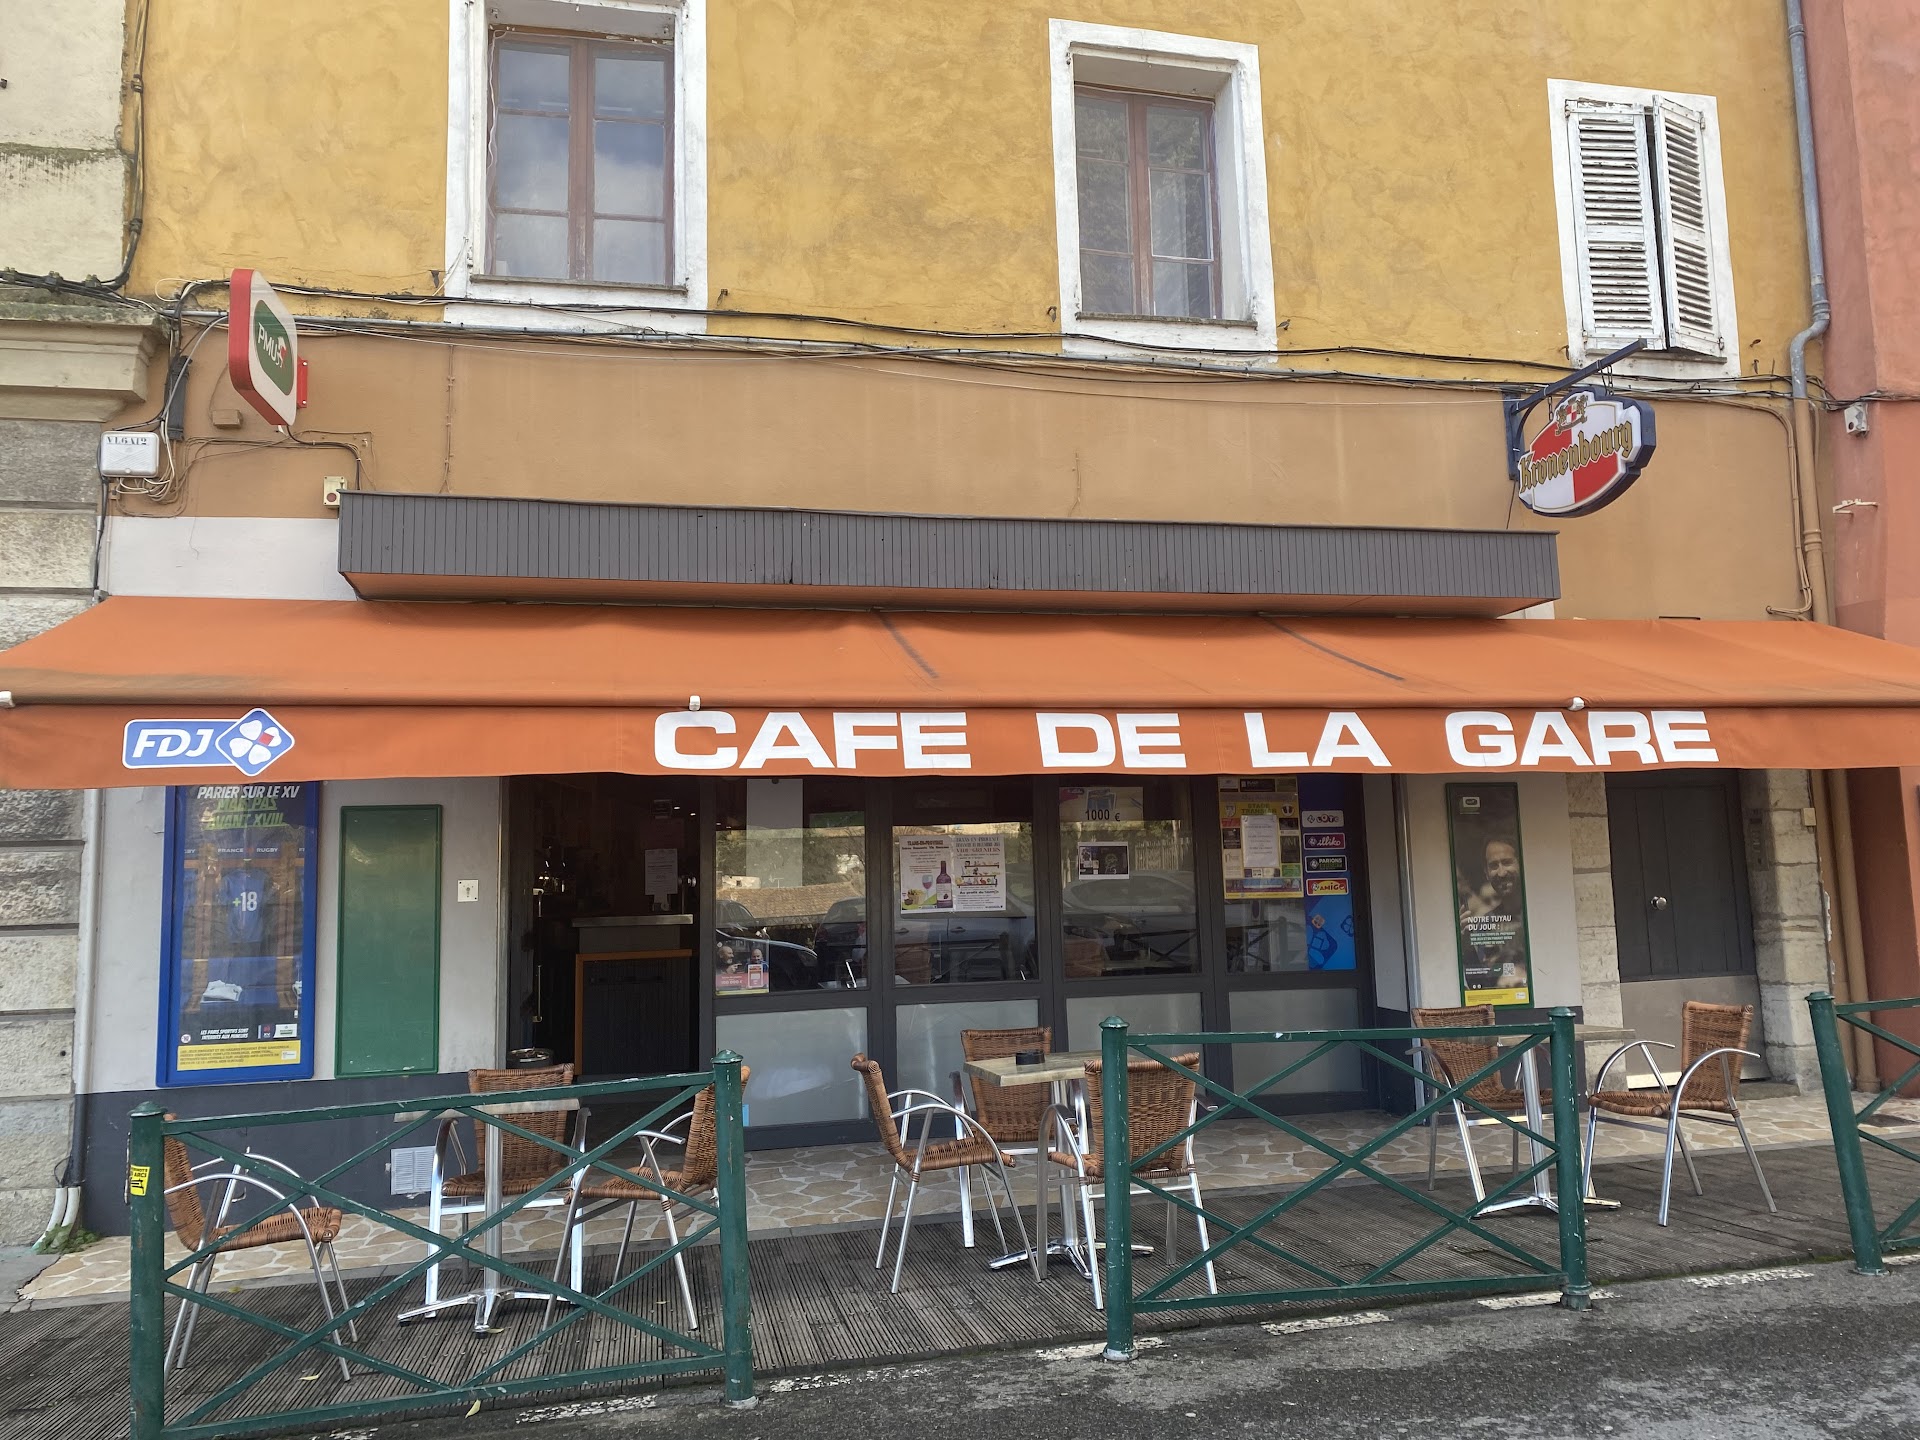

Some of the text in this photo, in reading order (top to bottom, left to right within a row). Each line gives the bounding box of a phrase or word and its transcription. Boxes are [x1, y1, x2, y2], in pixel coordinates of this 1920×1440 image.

[257, 322, 279, 363] PMU
[1519, 420, 1633, 494] Kronenbourg
[132, 728, 214, 758] FDJ
[654, 710, 1719, 770] CAFE DE LA GARE
[197, 785, 300, 799] PARIER SUR LE XV
[251, 797, 277, 810] PAS
[1085, 809, 1120, 821] 1000 €
[1317, 836, 1341, 846] illiko
[1467, 914, 1512, 923] NOTRE TUYAU
[1479, 923, 1496, 931] JOUR
